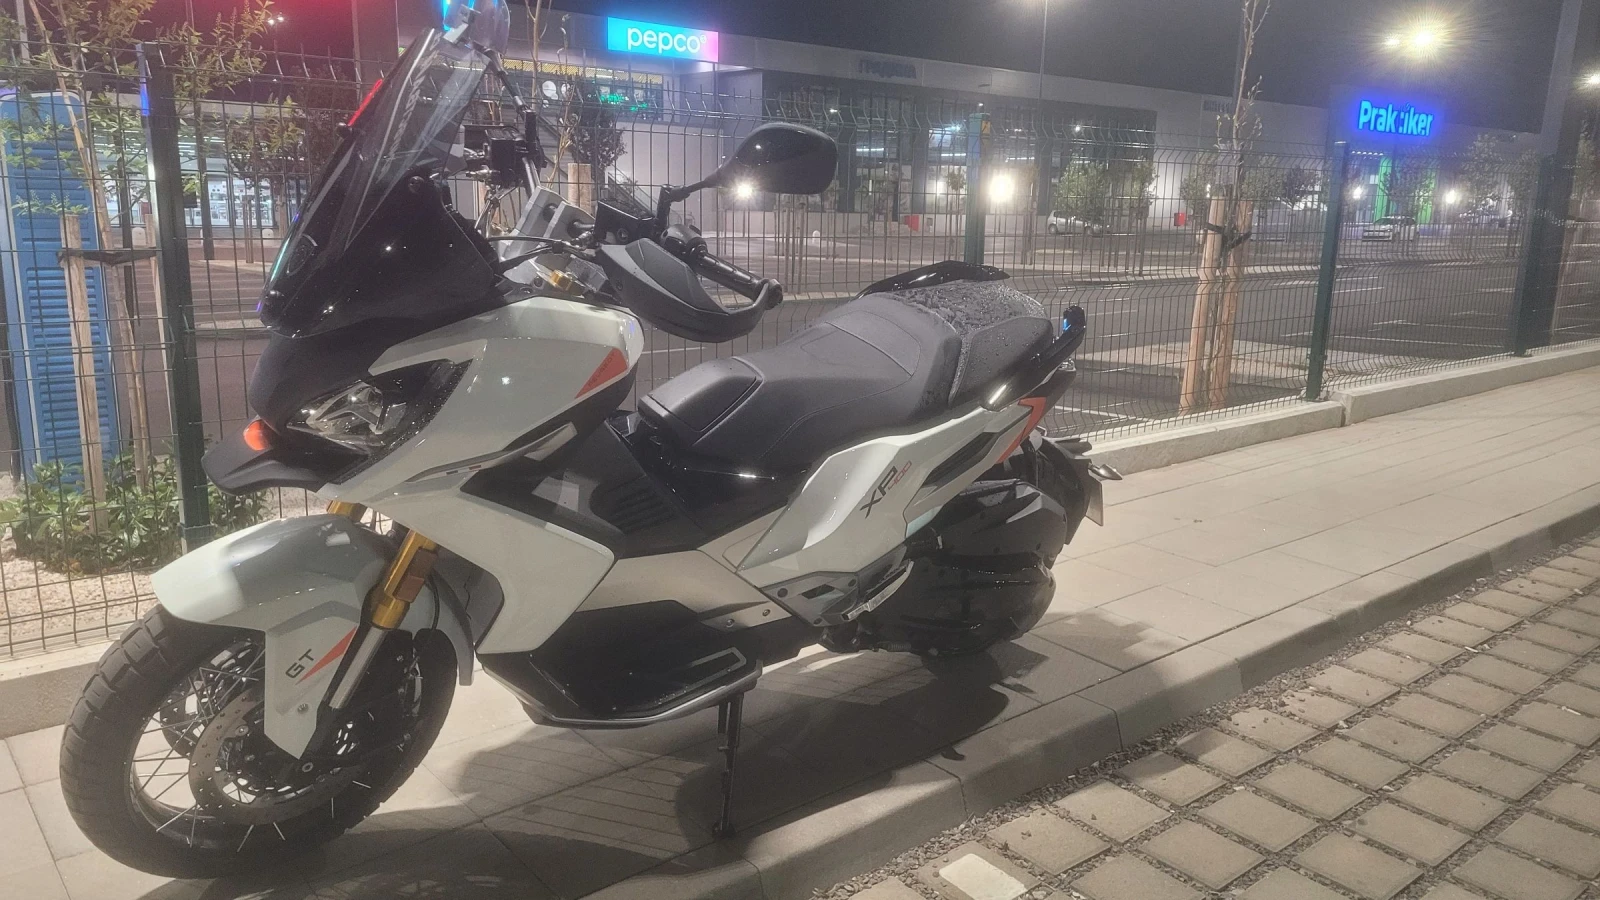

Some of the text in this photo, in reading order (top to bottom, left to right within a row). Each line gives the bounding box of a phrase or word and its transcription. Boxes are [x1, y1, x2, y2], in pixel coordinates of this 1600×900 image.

[627, 28, 701, 54] pepco
[859, 466, 898, 519] XP
[285, 648, 314, 678] GT
